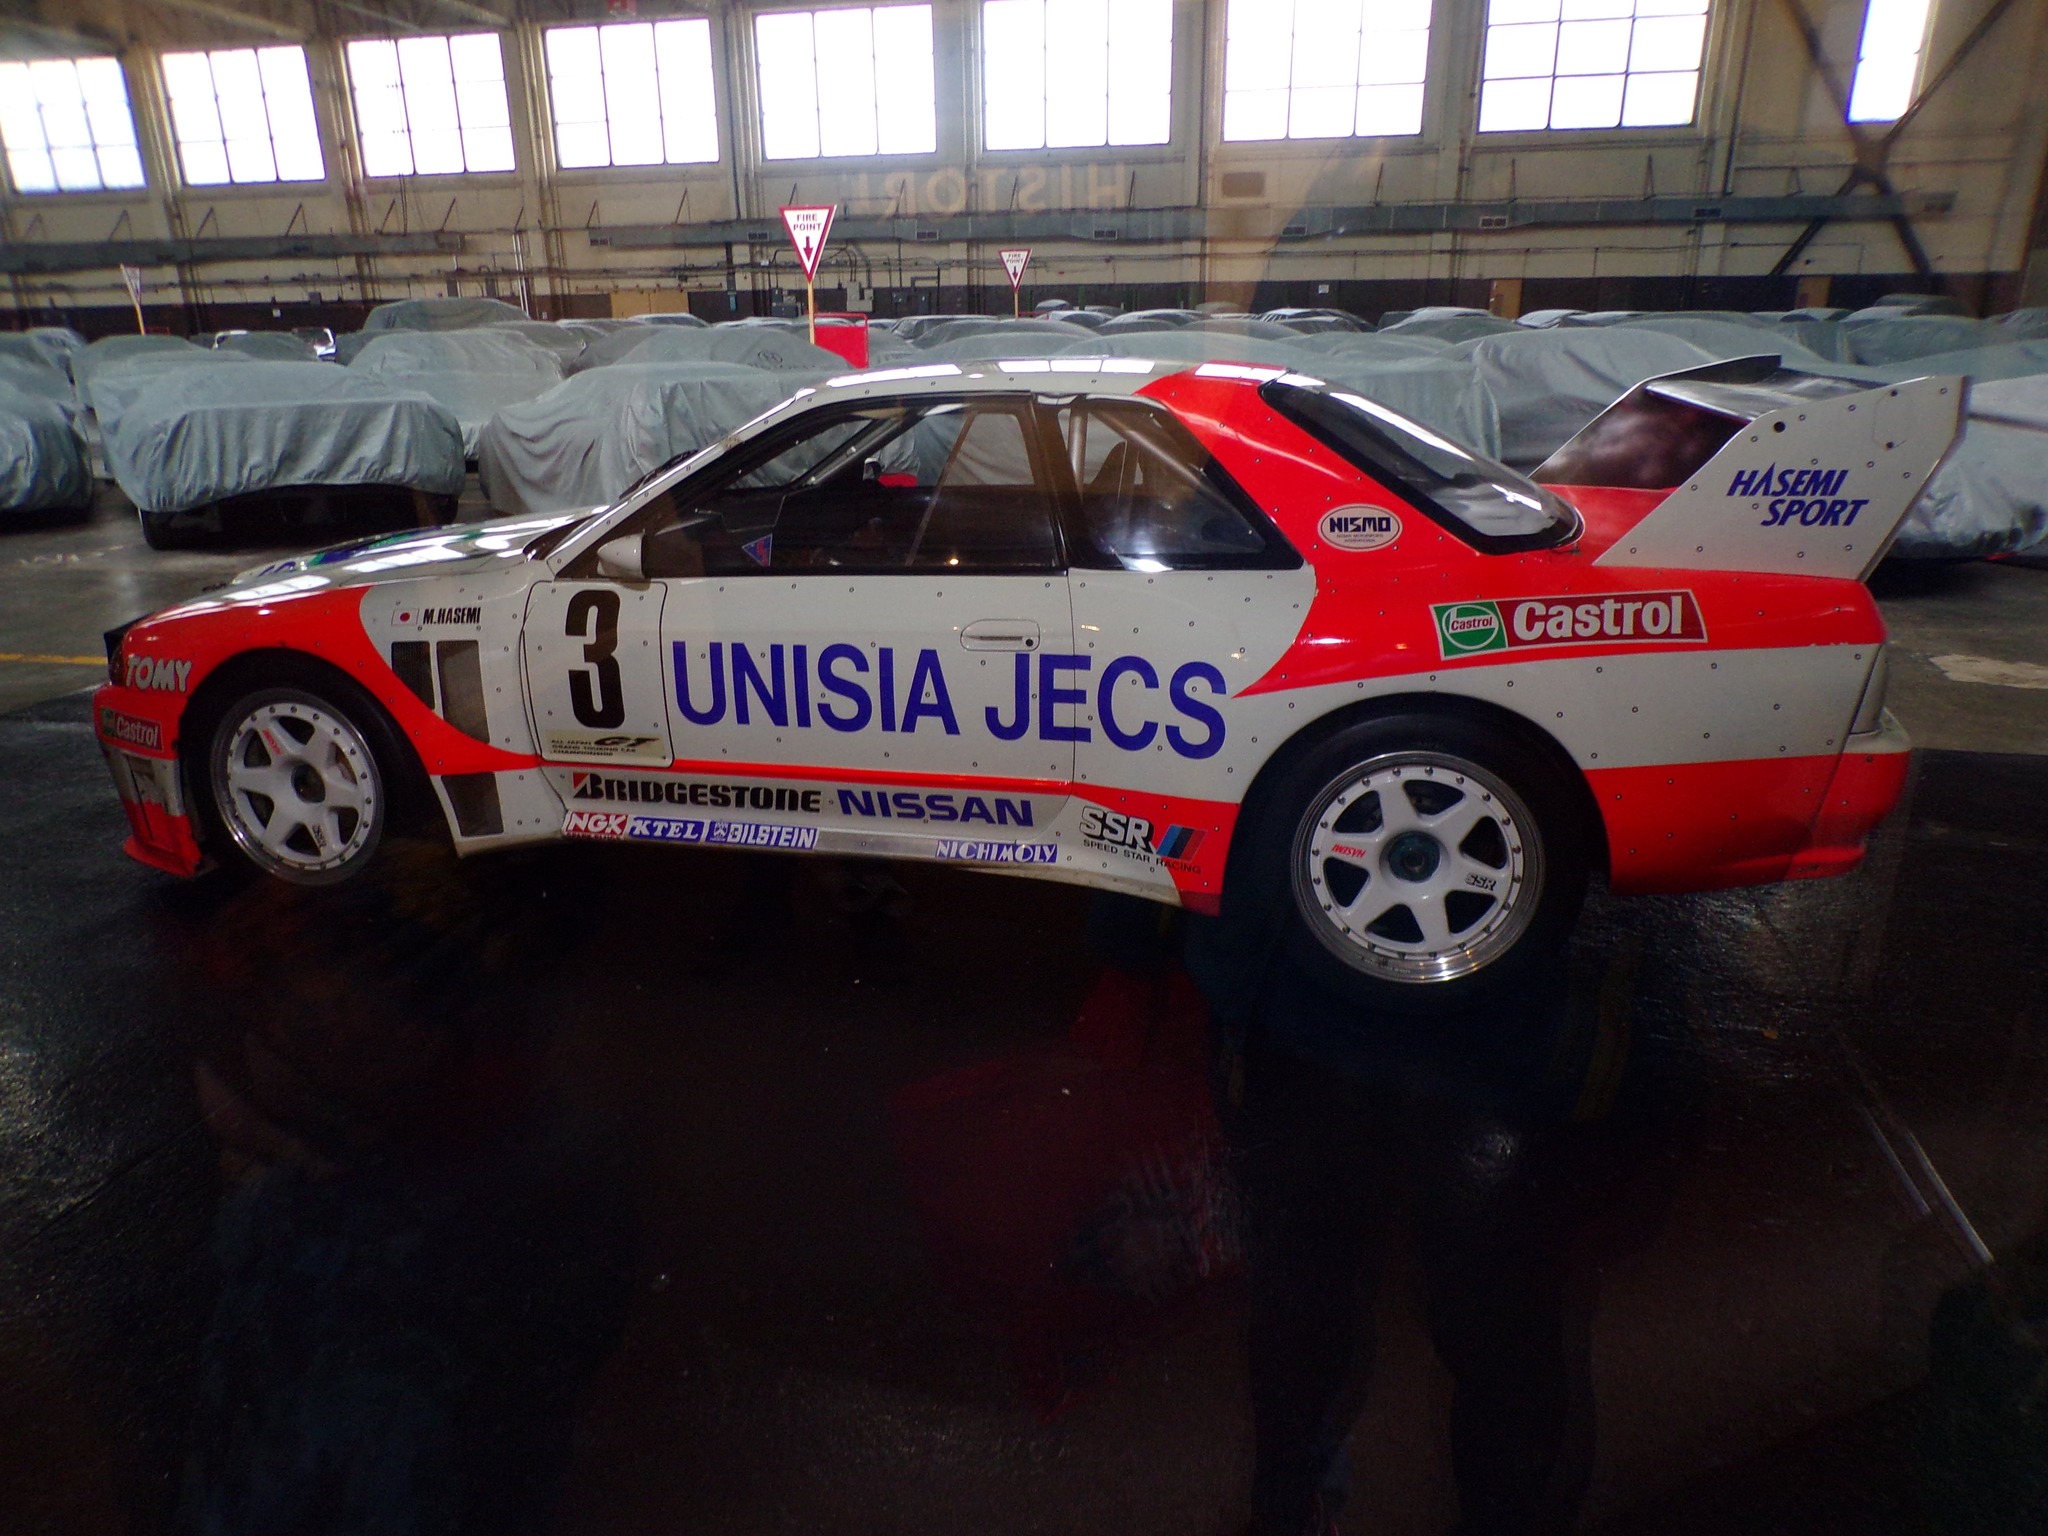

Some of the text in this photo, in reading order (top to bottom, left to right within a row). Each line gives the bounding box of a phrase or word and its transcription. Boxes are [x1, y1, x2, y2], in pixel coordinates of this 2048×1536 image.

[793, 223, 822, 231] POINT
[797, 213, 818, 222] FIRE
[1726, 462, 1849, 496] HASEMI
[1330, 517, 1391, 532] NISMO
[1760, 499, 1870, 526] SPORT
[422, 607, 481, 625] M.HASEMI
[1451, 617, 1493, 631] Castrol
[1513, 595, 1683, 641] Castrol
[565, 589, 625, 728] 3
[125, 655, 192, 693] TOMY
[671, 640, 1227, 760] UNISIA JECS
[117, 716, 159, 747] Castrol
[573, 773, 821, 813] BRIDGESTONE
[837, 789, 1034, 827] NISSAN
[567, 813, 626, 834] NGK
[727, 823, 816, 849] BILSTEIN
[1079, 805, 1155, 855] SSR
[936, 840, 1057, 863] NICHIMOLY
[1083, 839, 1202, 875] SPEED STAR RACING
[1465, 872, 1497, 892] SSR
